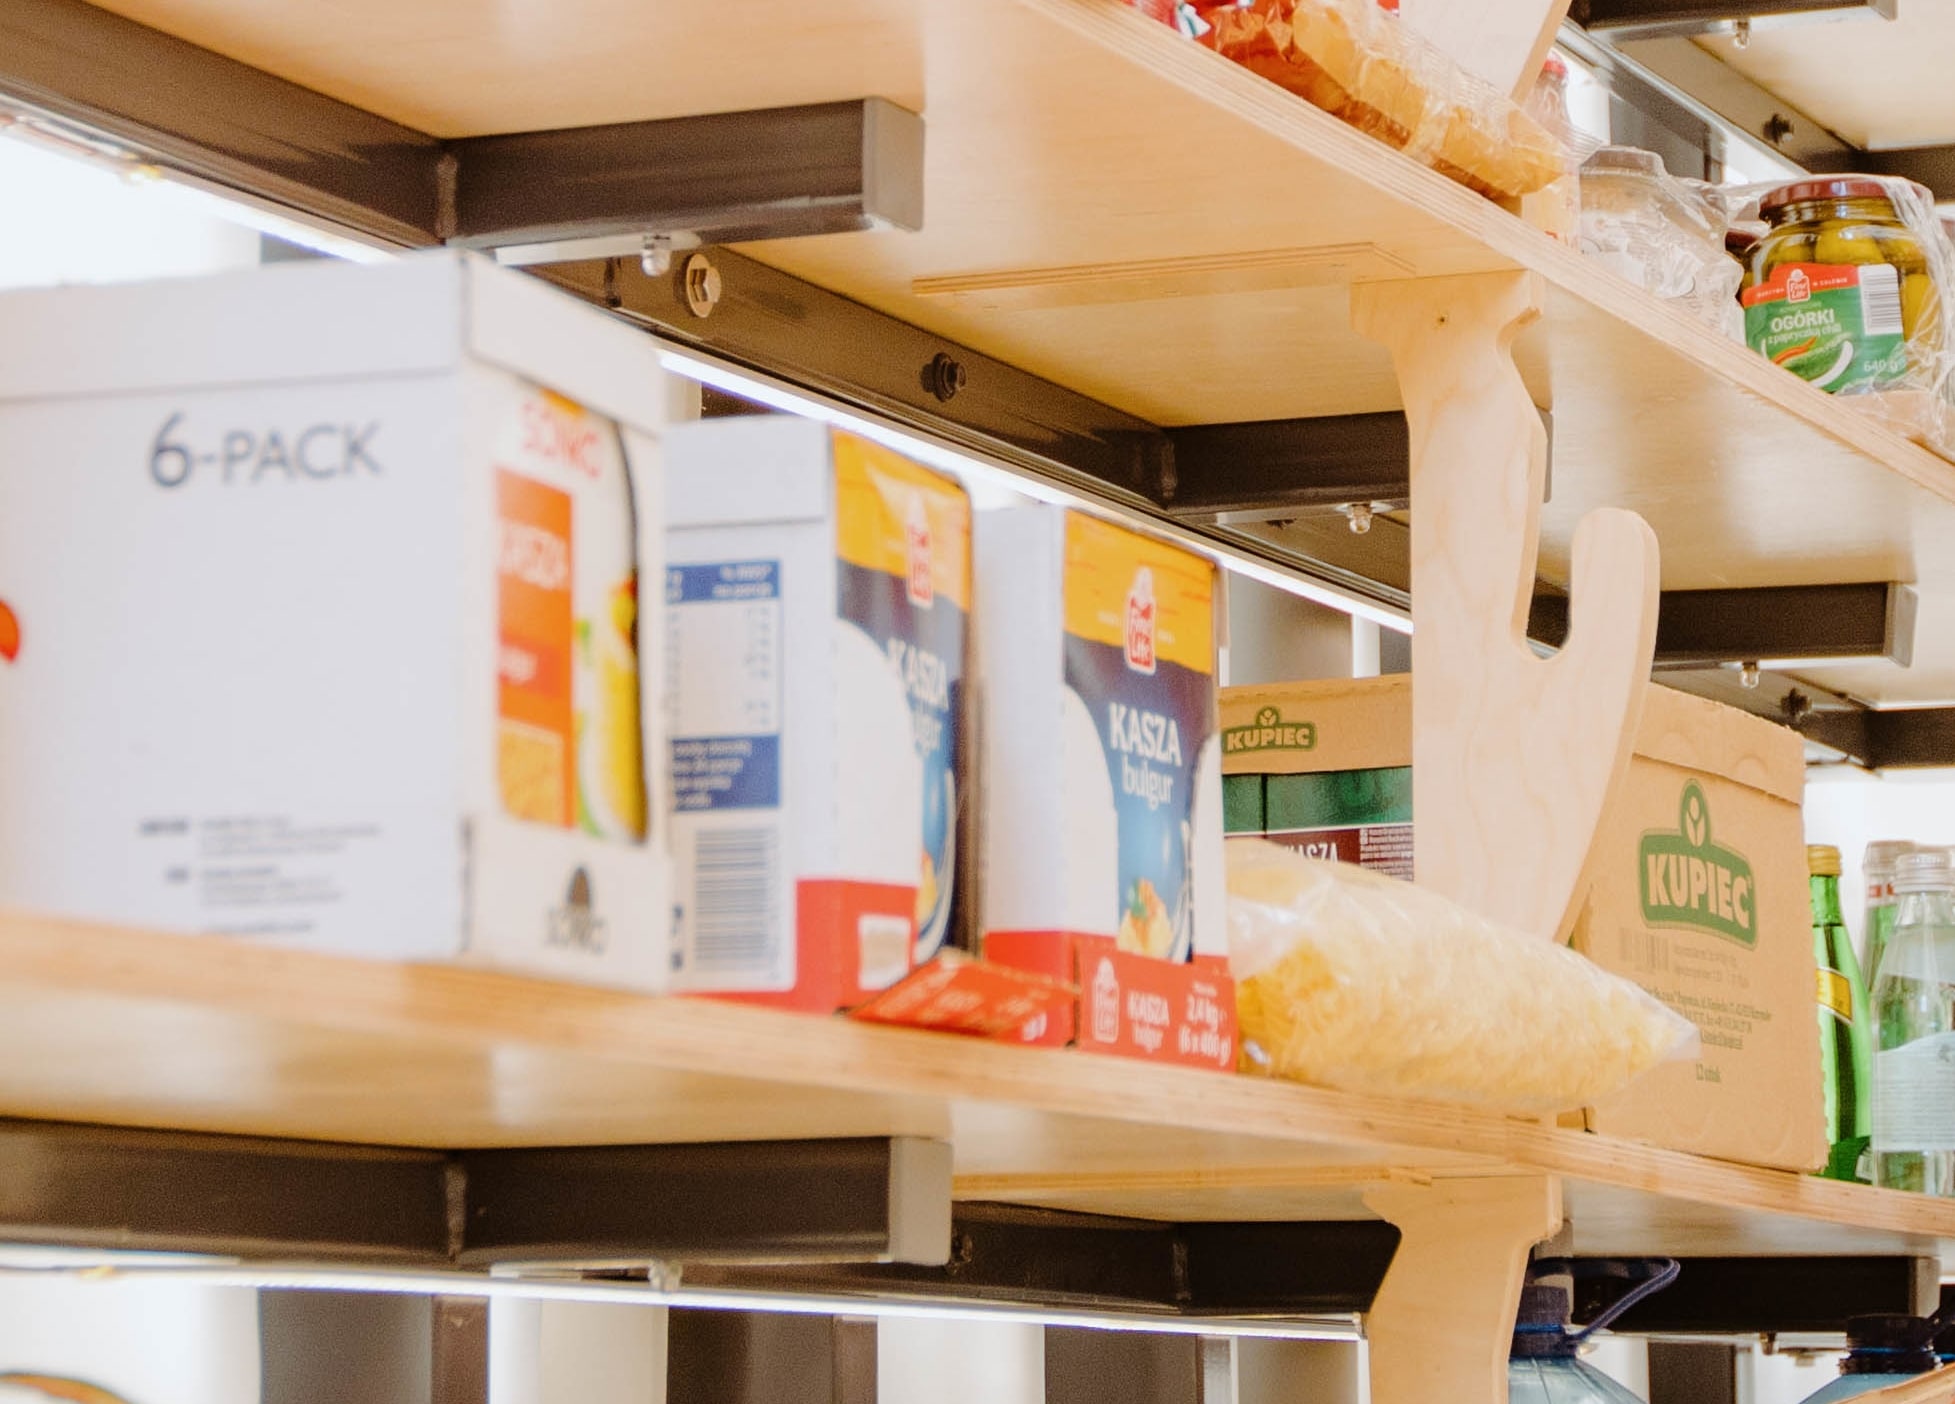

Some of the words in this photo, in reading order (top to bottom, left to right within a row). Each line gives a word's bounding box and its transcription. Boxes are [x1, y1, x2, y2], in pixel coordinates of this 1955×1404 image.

[1770, 308, 1835, 333] OGÓRKI
[150, 411, 382, 488] 6-PACK
[1109, 701, 1183, 767] KASZA
[1227, 728, 1310, 751] KUPIEC
[1121, 754, 1174, 809] bulgur
[1647, 853, 1750, 929] KUPIEC
